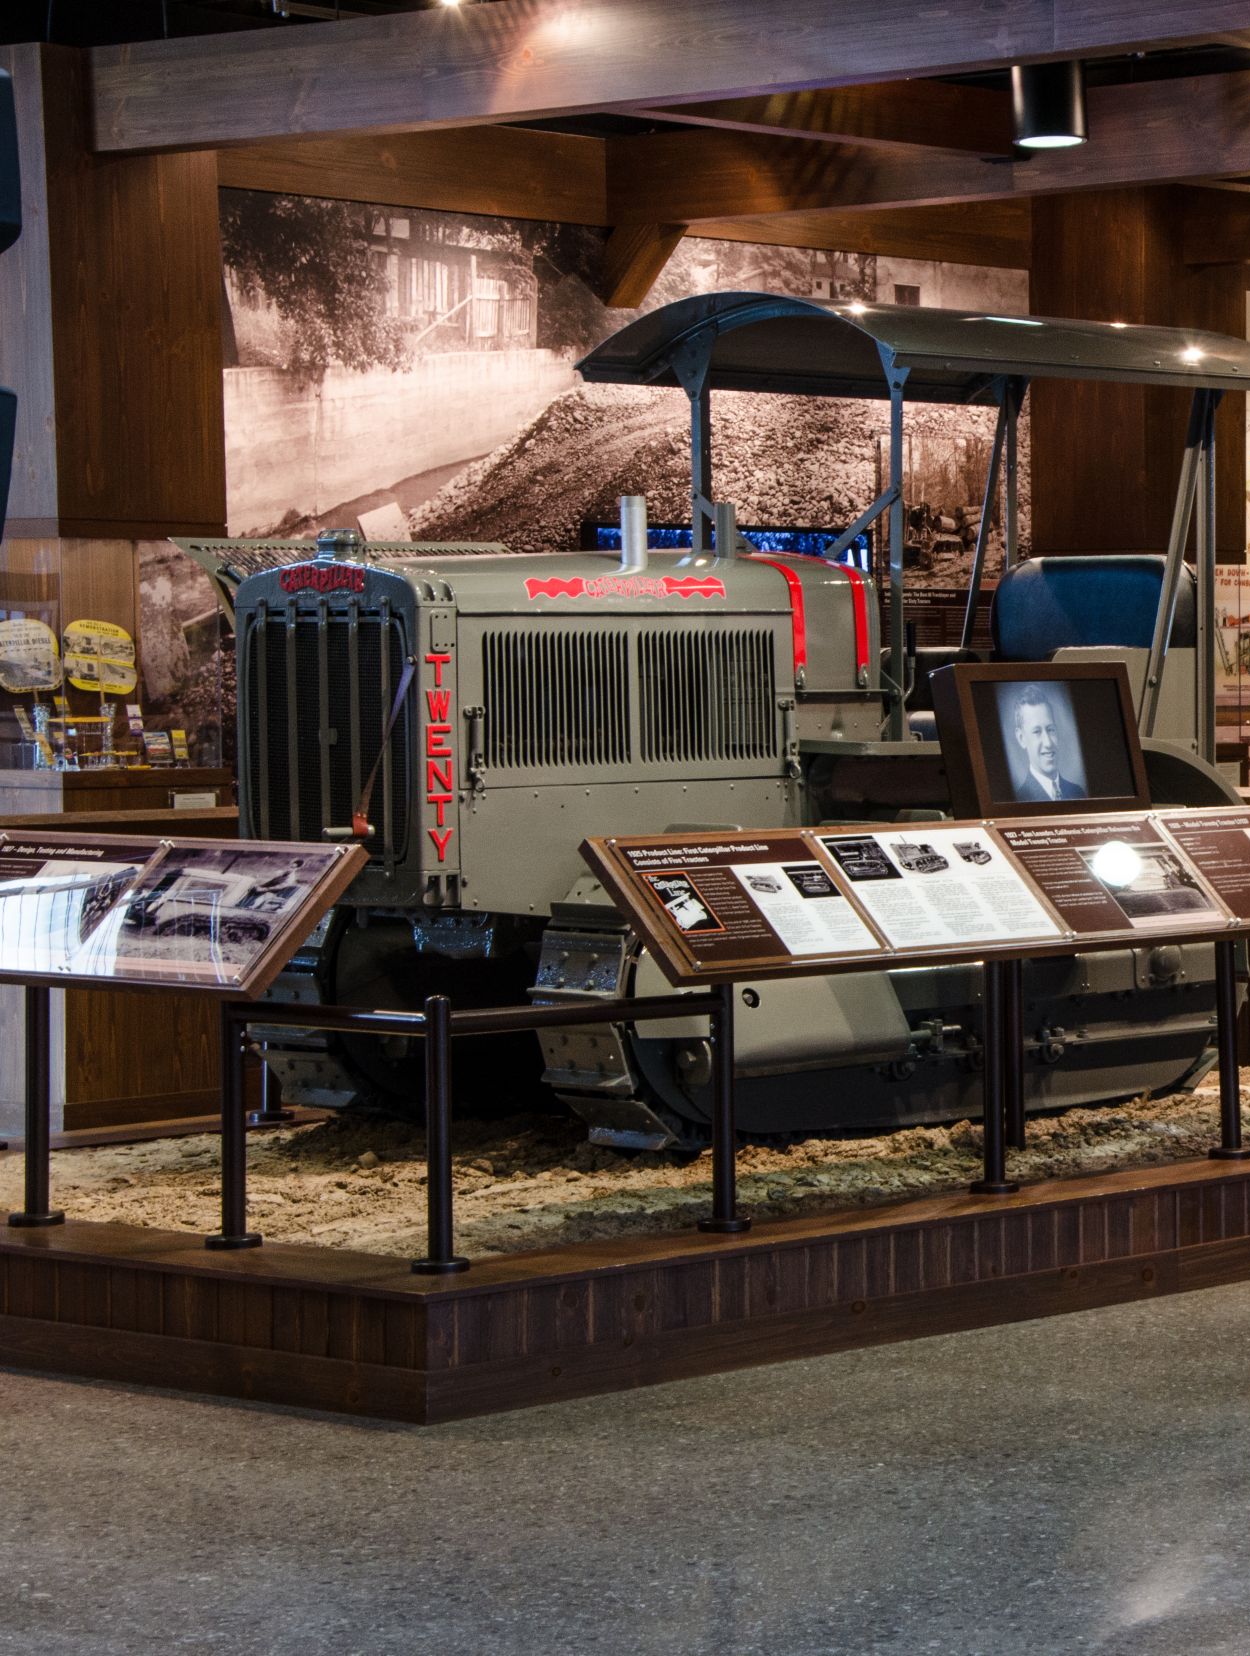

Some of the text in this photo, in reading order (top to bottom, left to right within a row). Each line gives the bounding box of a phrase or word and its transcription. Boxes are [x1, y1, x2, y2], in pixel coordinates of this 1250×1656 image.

[280, 564, 365, 593] CATERPILLAR
[584, 576, 667, 598] CATERPILLAR
[425, 653, 454, 862] TWENTY
[633, 858, 661, 866] Consists
[668, 857, 683, 865] Five
[643, 848, 668, 856] Product
[683, 847, 699, 855] First
[698, 846, 730, 854] Caterpillar
